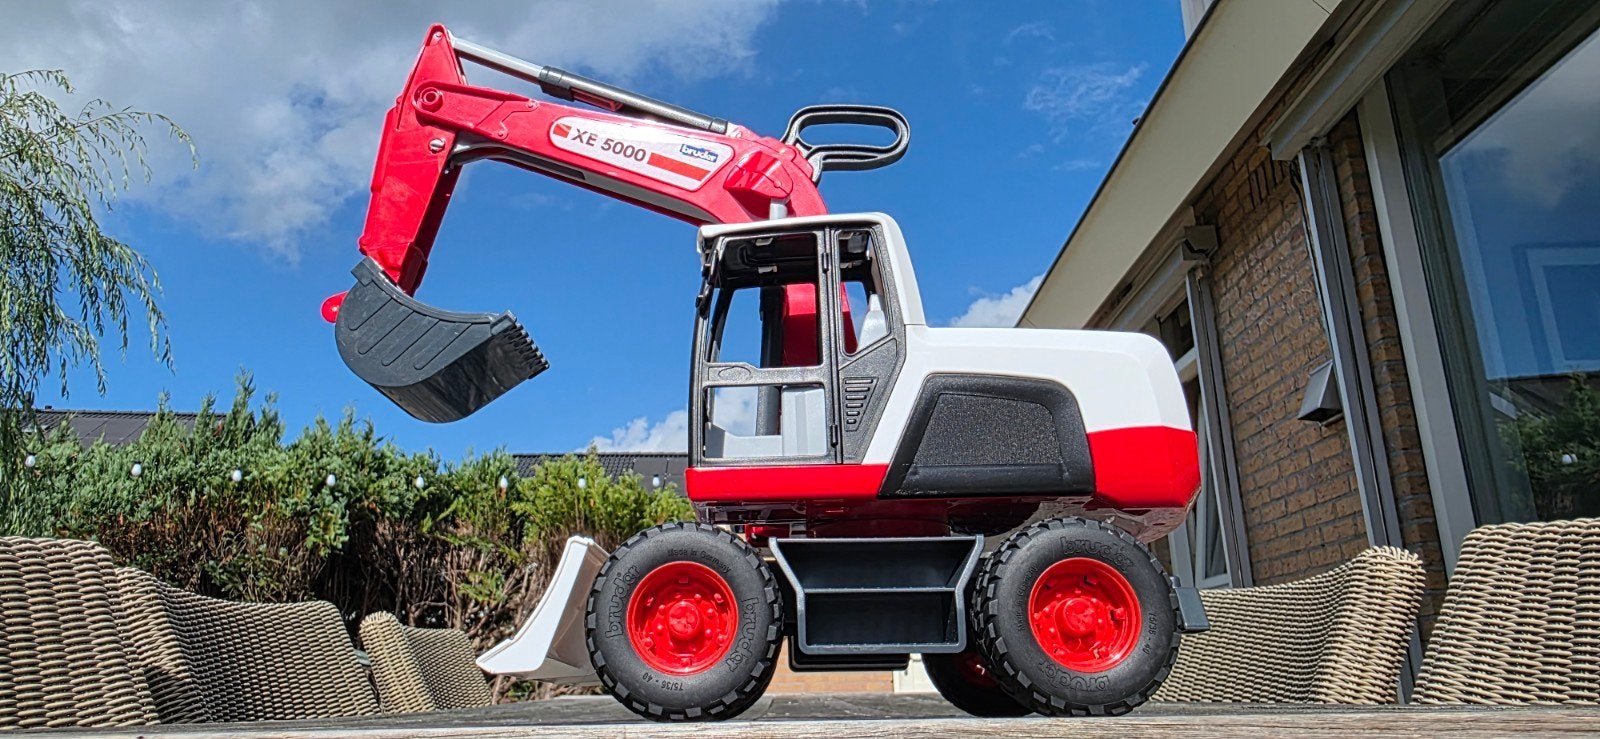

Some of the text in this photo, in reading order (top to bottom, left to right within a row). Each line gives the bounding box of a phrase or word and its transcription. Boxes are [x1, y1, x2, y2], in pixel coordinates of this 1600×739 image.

[571, 128, 647, 162] XE 5000
[681, 144, 718, 162] bruder
[699, 550, 731, 574] Germany
[605, 564, 640, 639] bruder
[725, 597, 760, 673] bruder
[642, 672, 653, 683] 40
[660, 680, 684, 691] 75/36
